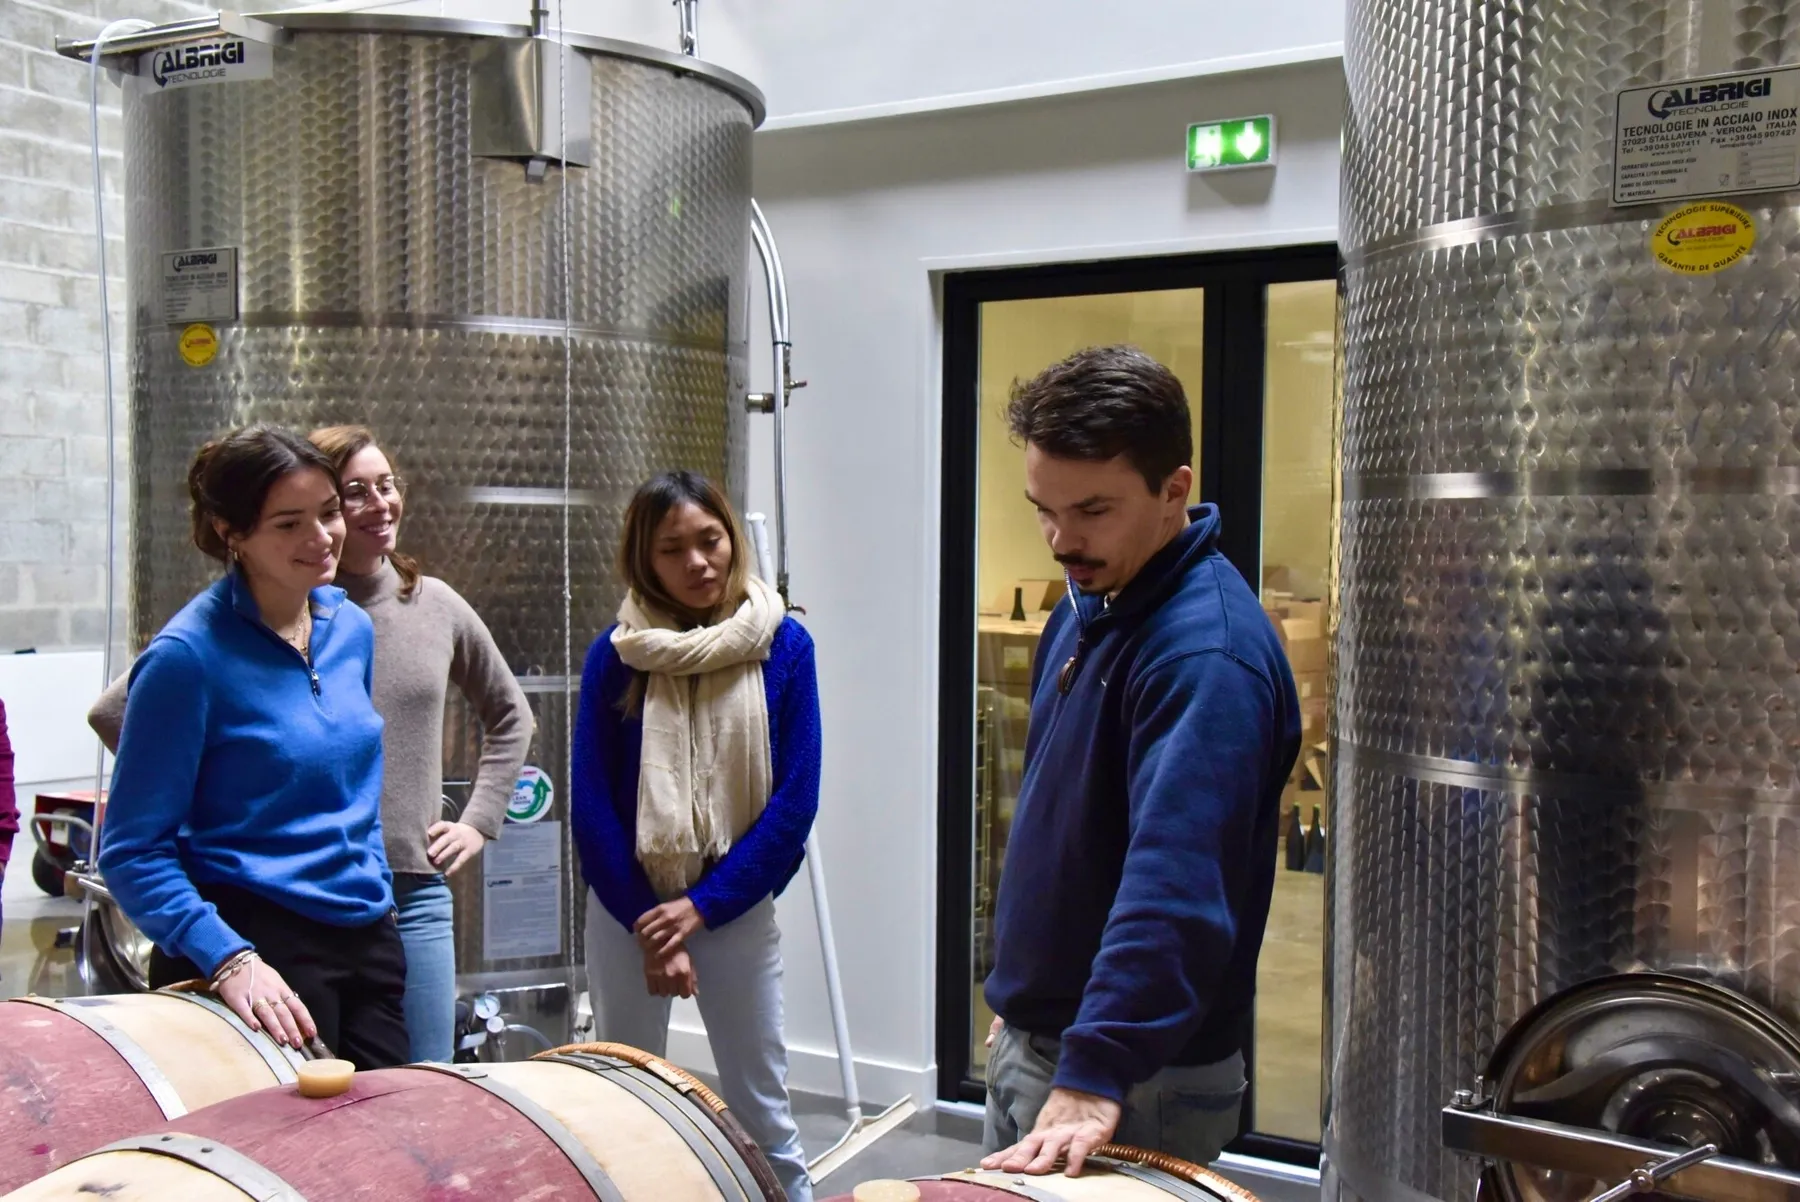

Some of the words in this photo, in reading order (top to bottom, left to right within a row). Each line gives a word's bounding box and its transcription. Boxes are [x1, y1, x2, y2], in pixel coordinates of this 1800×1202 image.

[161, 42, 244, 74] ALBRIGI
[168, 68, 226, 83] TECNOLOGIE
[1662, 77, 1772, 109] ALBRIGI
[1671, 101, 1749, 117] TECNOLOGIE
[1622, 137, 1647, 147] 37023
[1648, 130, 1707, 144] STALLAVENA
[1716, 124, 1757, 135] VERONA
[1766, 120, 1797, 130] ITALIA
[1623, 120, 1693, 138] TECNOLOGIE
[1697, 117, 1709, 129] IN
[1713, 111, 1763, 127] ACCIAIO
[1767, 107, 1798, 121] INOX
[1710, 136, 1726, 144] Fax
[1764, 128, 1797, 138] 907427
[1655, 205, 1707, 237] TECHNOLOGIE
[1675, 224, 1737, 240] ALBRIGI
[1658, 252, 1696, 272] GARANTIE
[1699, 264, 1709, 272] DE
